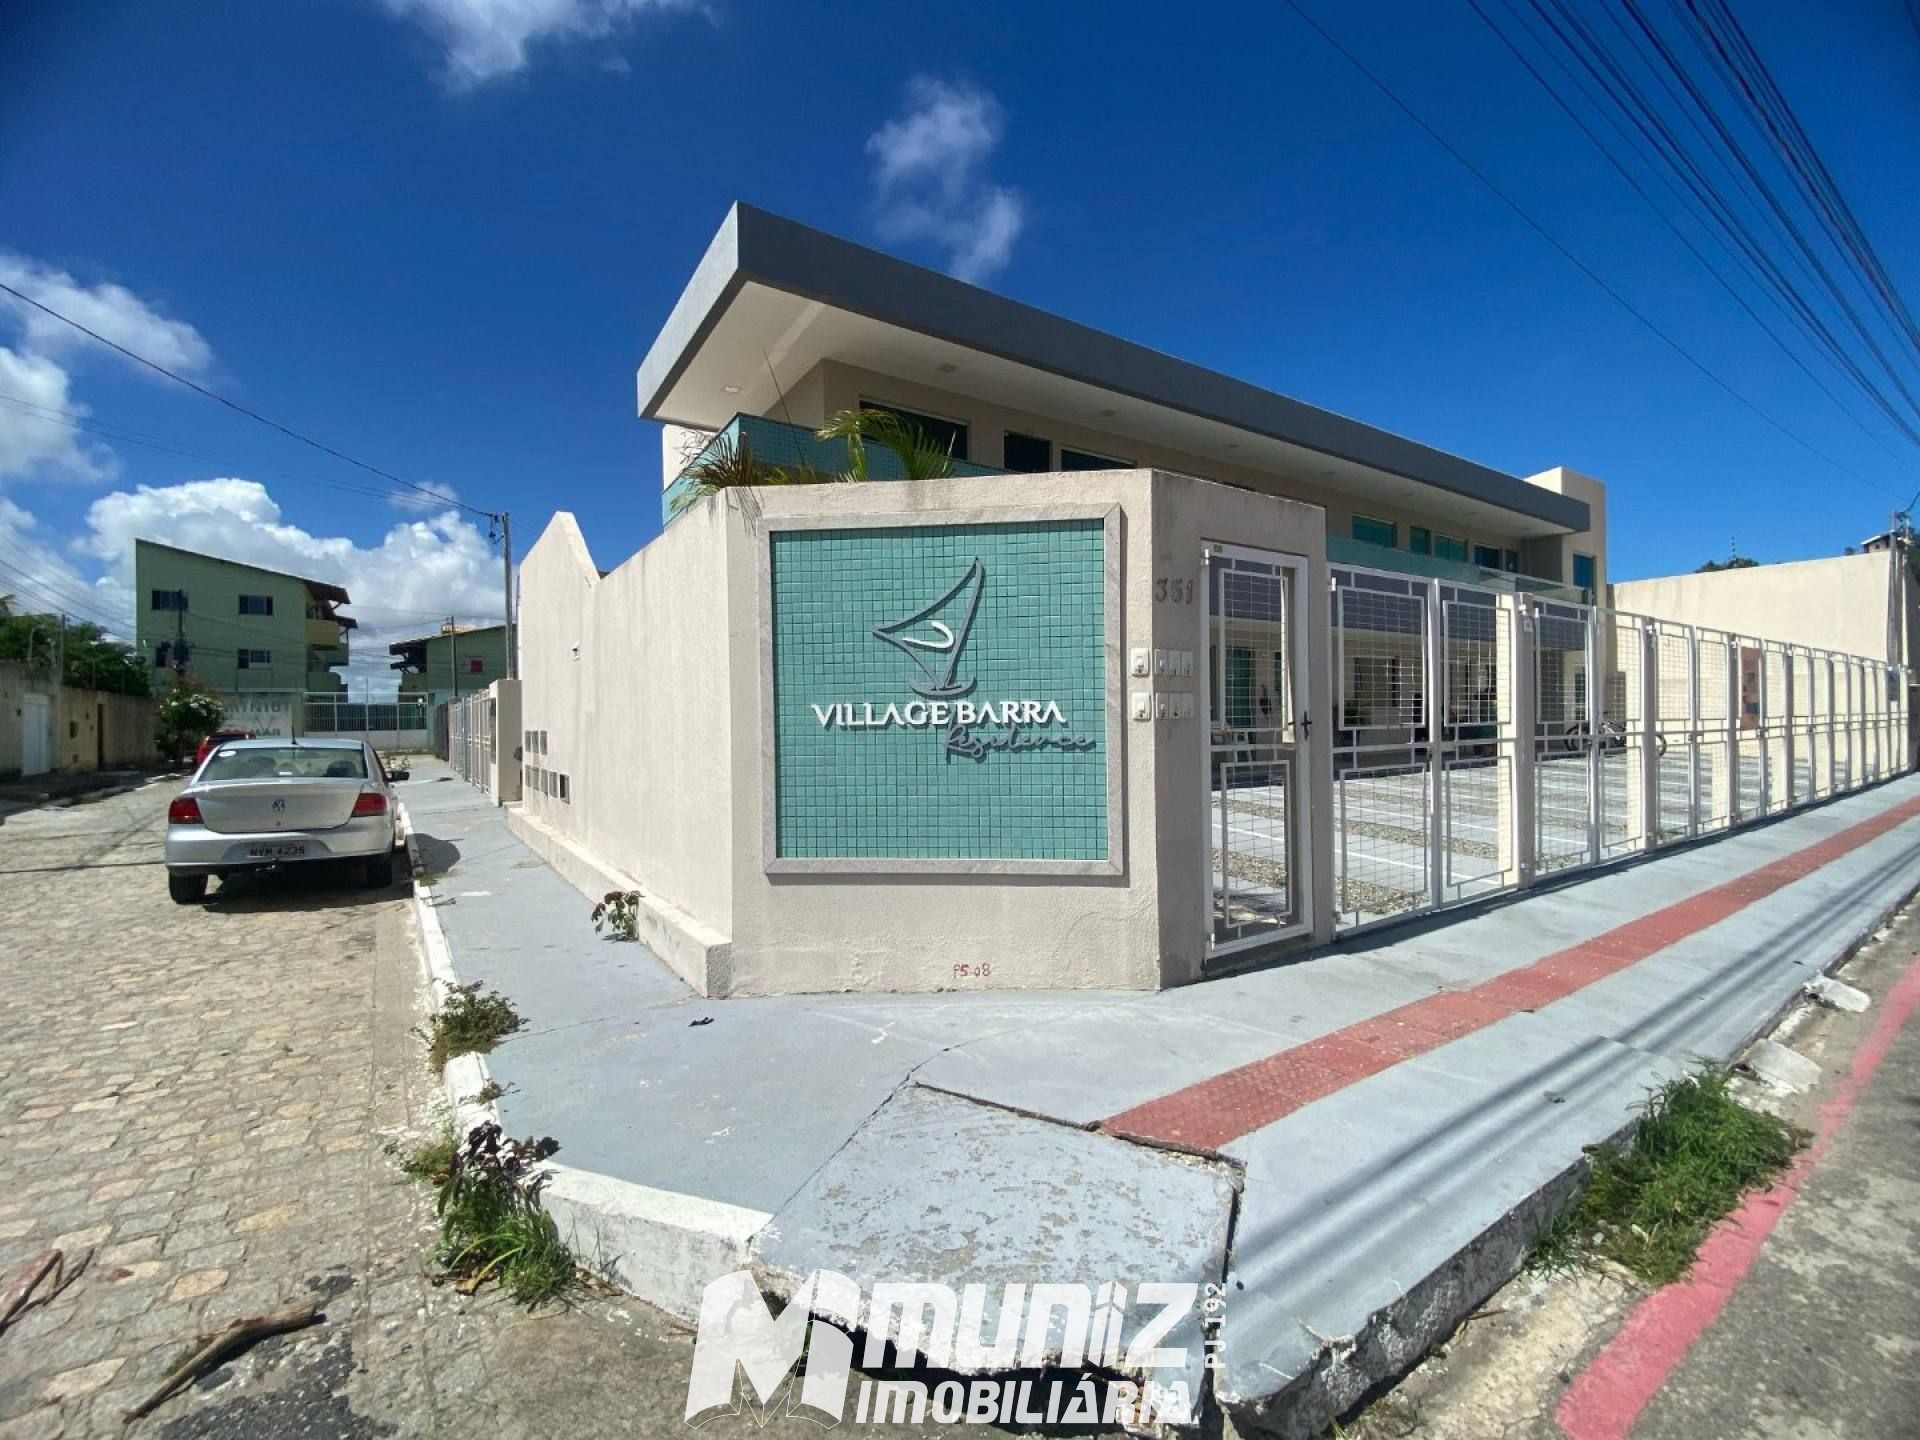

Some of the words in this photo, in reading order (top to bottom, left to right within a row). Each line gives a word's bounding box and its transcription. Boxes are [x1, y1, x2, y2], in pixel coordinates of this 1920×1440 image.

[811, 701, 951, 728] VILLAGE
[955, 699, 1067, 726] BARRA
[943, 720, 1096, 760] Residence
